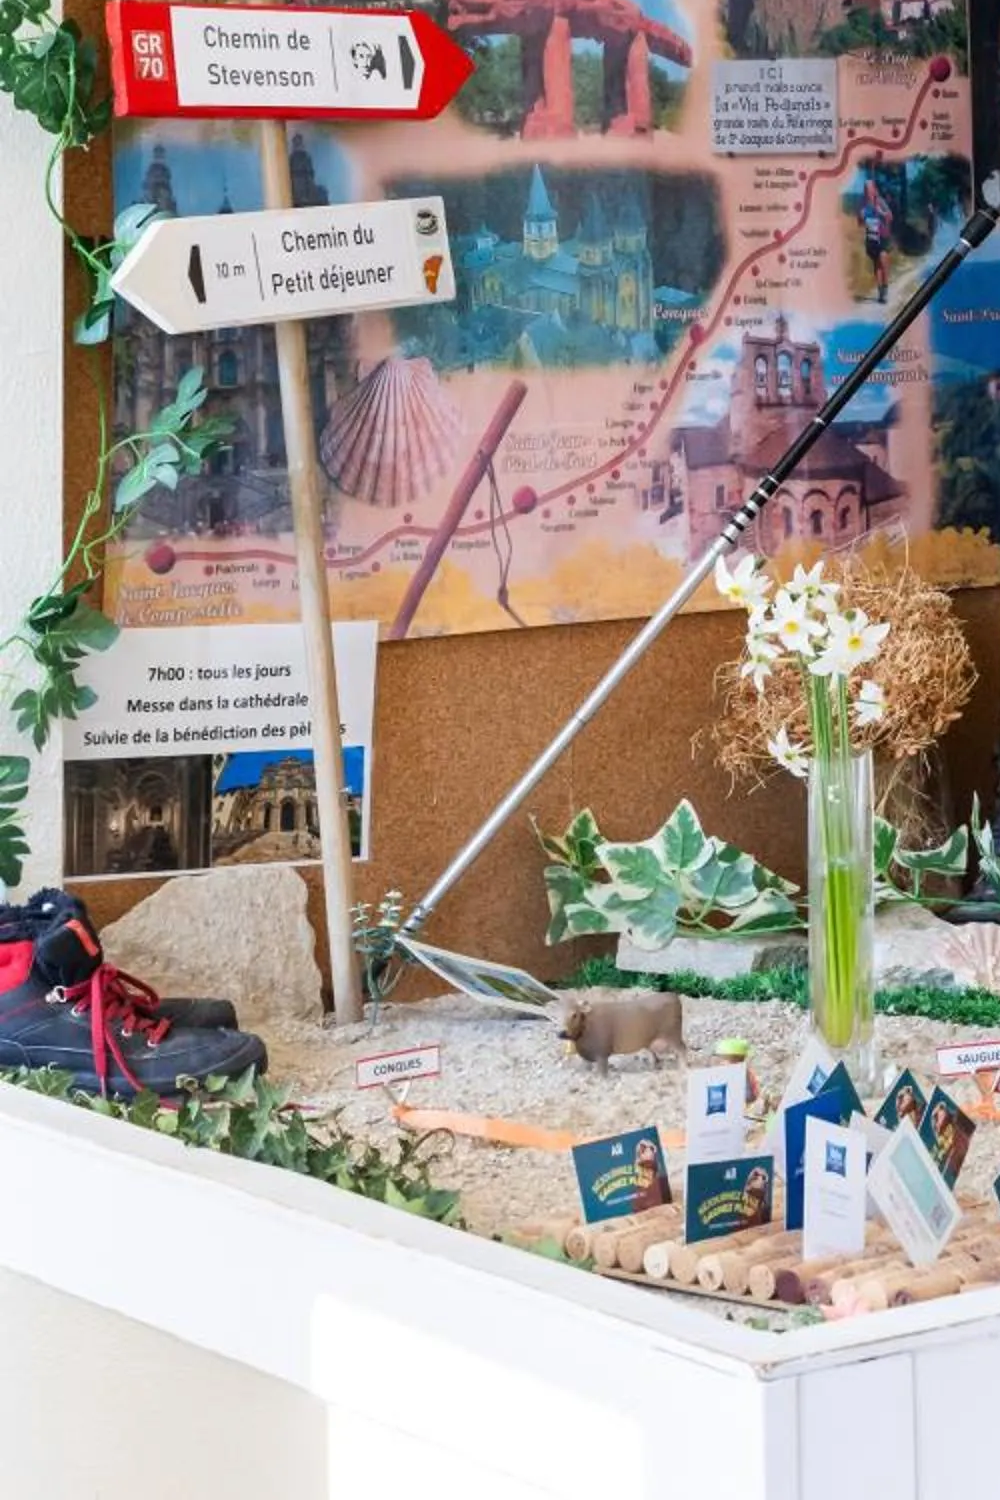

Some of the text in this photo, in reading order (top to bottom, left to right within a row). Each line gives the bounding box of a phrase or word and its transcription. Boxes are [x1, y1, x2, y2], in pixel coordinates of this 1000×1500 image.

[132, 33, 161, 52] GR
[203, 25, 311, 50] Chemin de
[138, 58, 163, 78] 70
[207, 64, 315, 87] Stevenson
[281, 222, 374, 253] Chemin du
[215, 263, 245, 278] 10 m
[271, 264, 395, 295] Petit déjeuner
[148, 667, 185, 682] 7h00
[197, 666, 228, 680] tous
[231, 664, 252, 679] les
[253, 664, 292, 681] jours
[127, 693, 309, 713] Messe dans la cathédrale
[83, 729, 128, 745] Suivie
[132, 728, 151, 744] de
[155, 726, 169, 743] la
[173, 723, 257, 742] bénédiction
[261, 721, 286, 738] des
[373, 1057, 423, 1076] CONQUES
